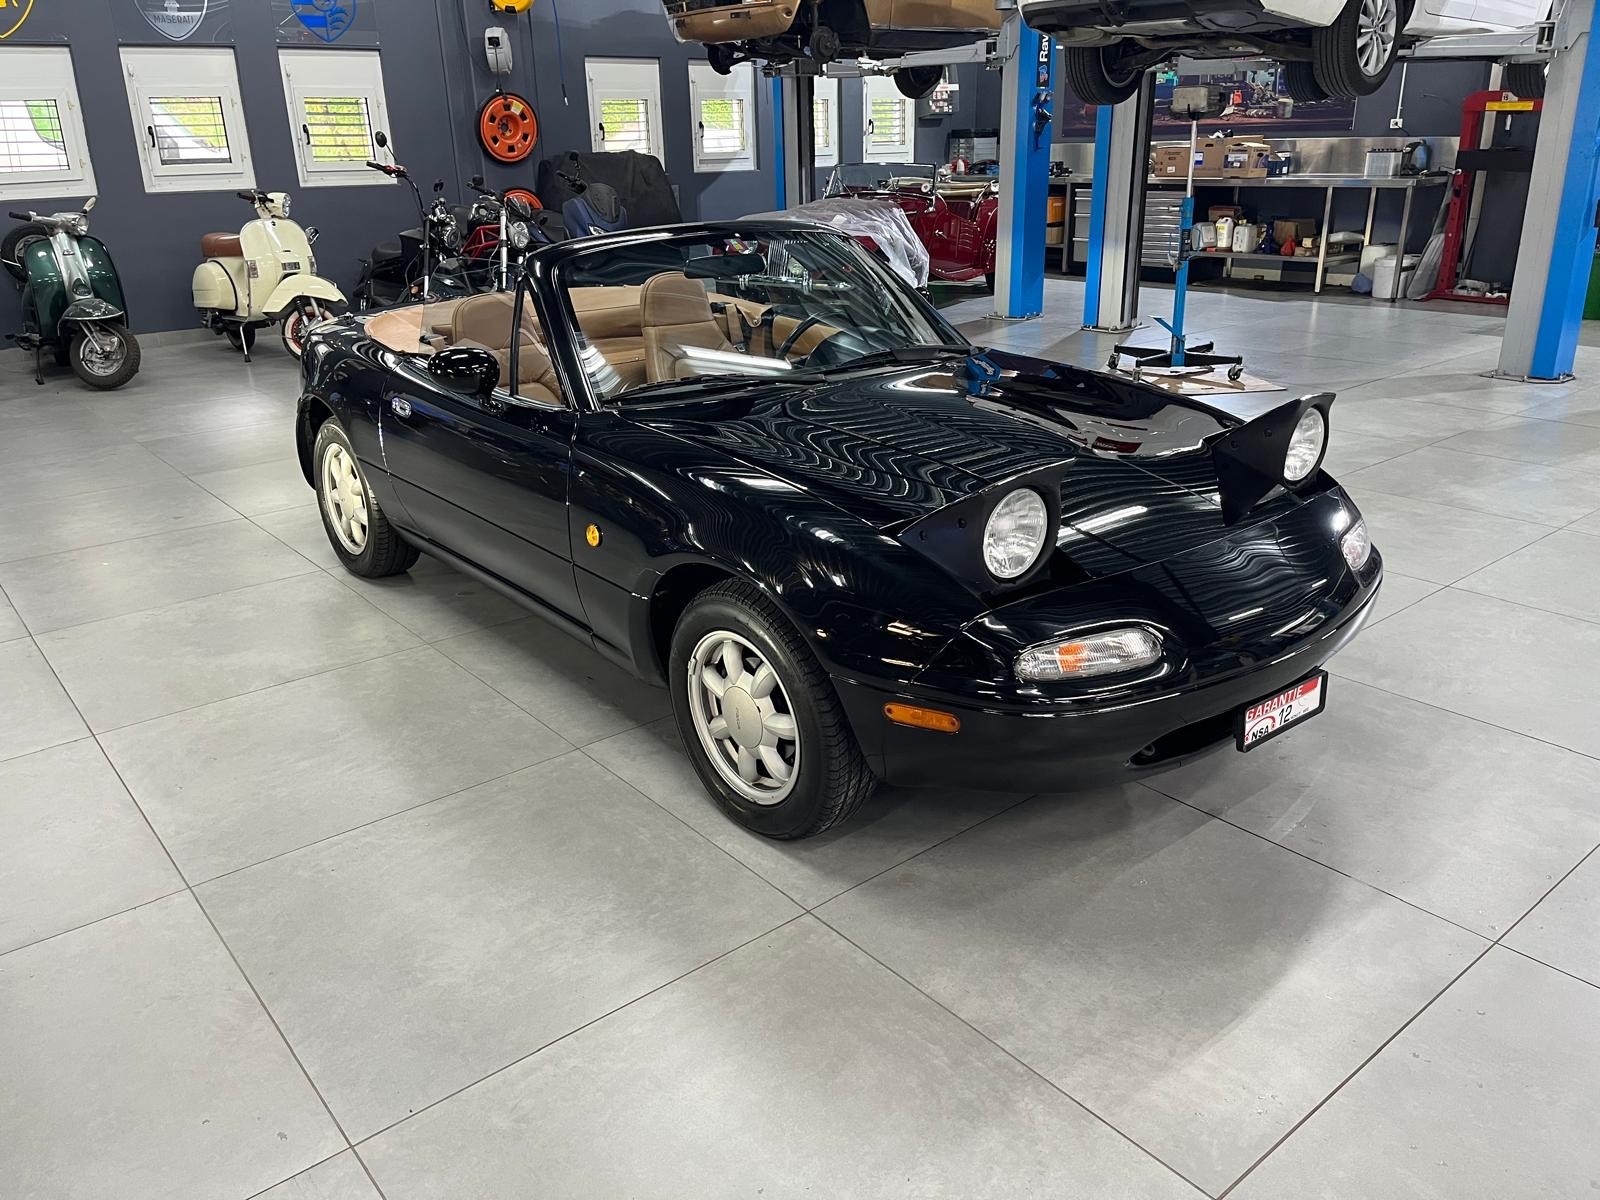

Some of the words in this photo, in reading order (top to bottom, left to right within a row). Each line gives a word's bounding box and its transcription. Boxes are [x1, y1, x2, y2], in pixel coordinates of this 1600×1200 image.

[153, 14, 194, 24] MASERATI
[1246, 684, 1304, 720] GARANTIE
[1278, 704, 1293, 725] 12
[1251, 725, 1269, 741] NSA
